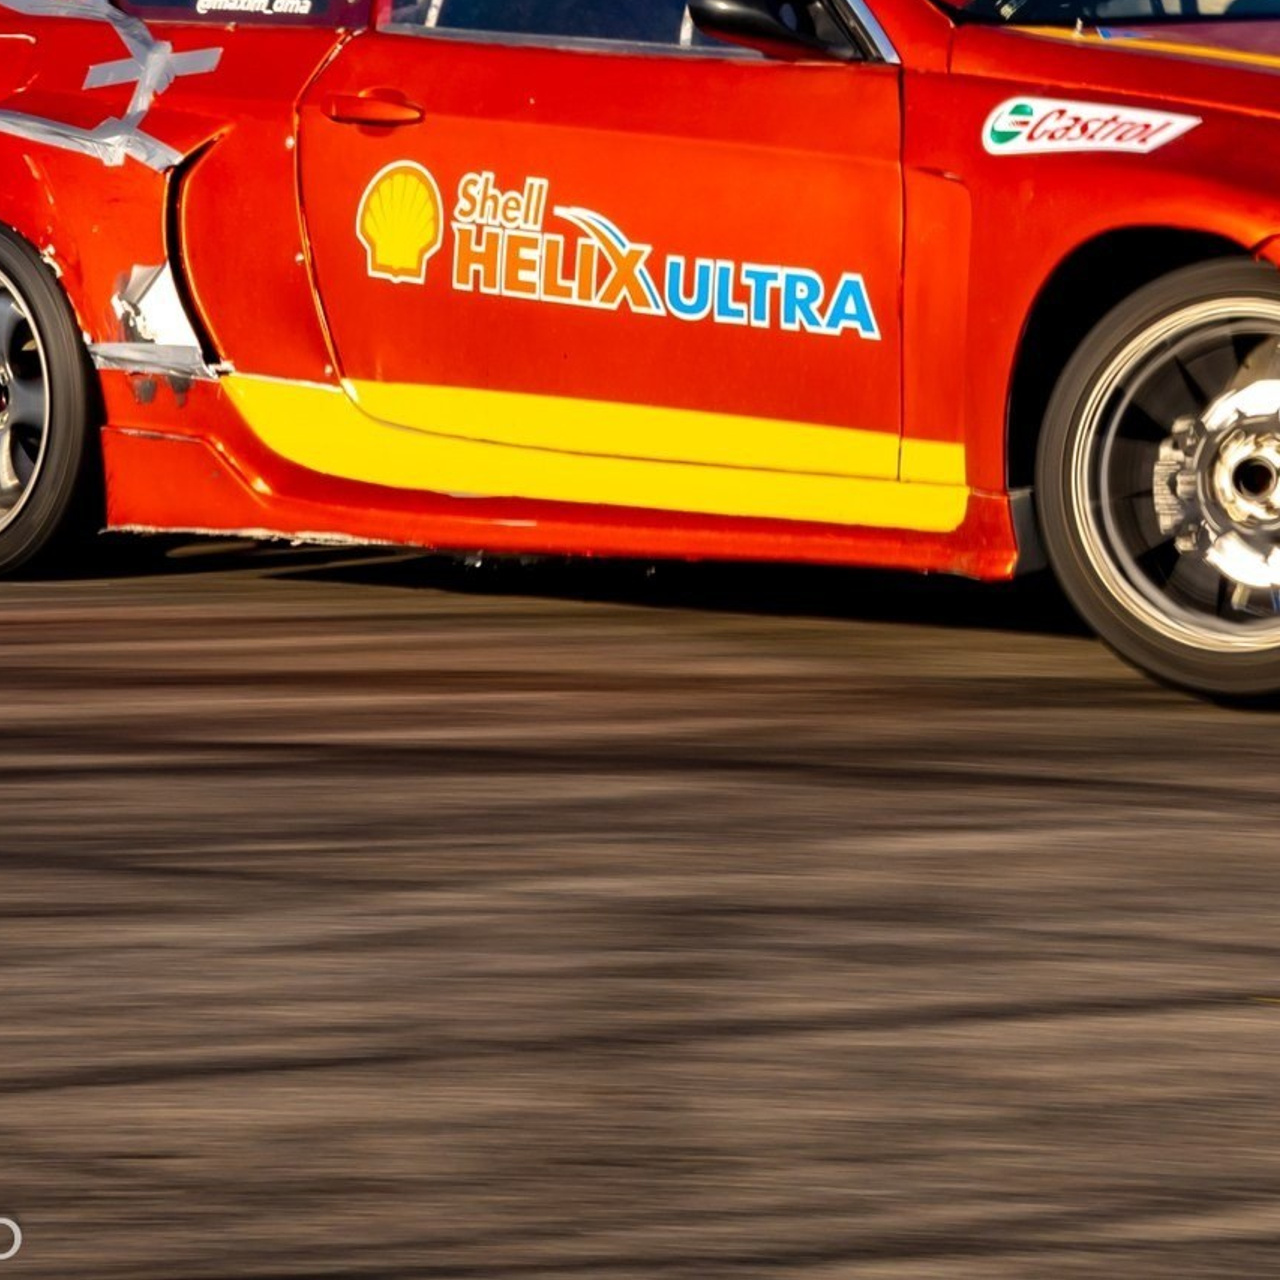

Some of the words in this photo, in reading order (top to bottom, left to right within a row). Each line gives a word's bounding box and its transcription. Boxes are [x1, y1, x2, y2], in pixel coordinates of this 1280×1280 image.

[1026, 108, 1174, 144] Castrol
[457, 171, 548, 231] Shell
[452, 208, 666, 317] HELIX
[665, 255, 882, 340] ULTRA
